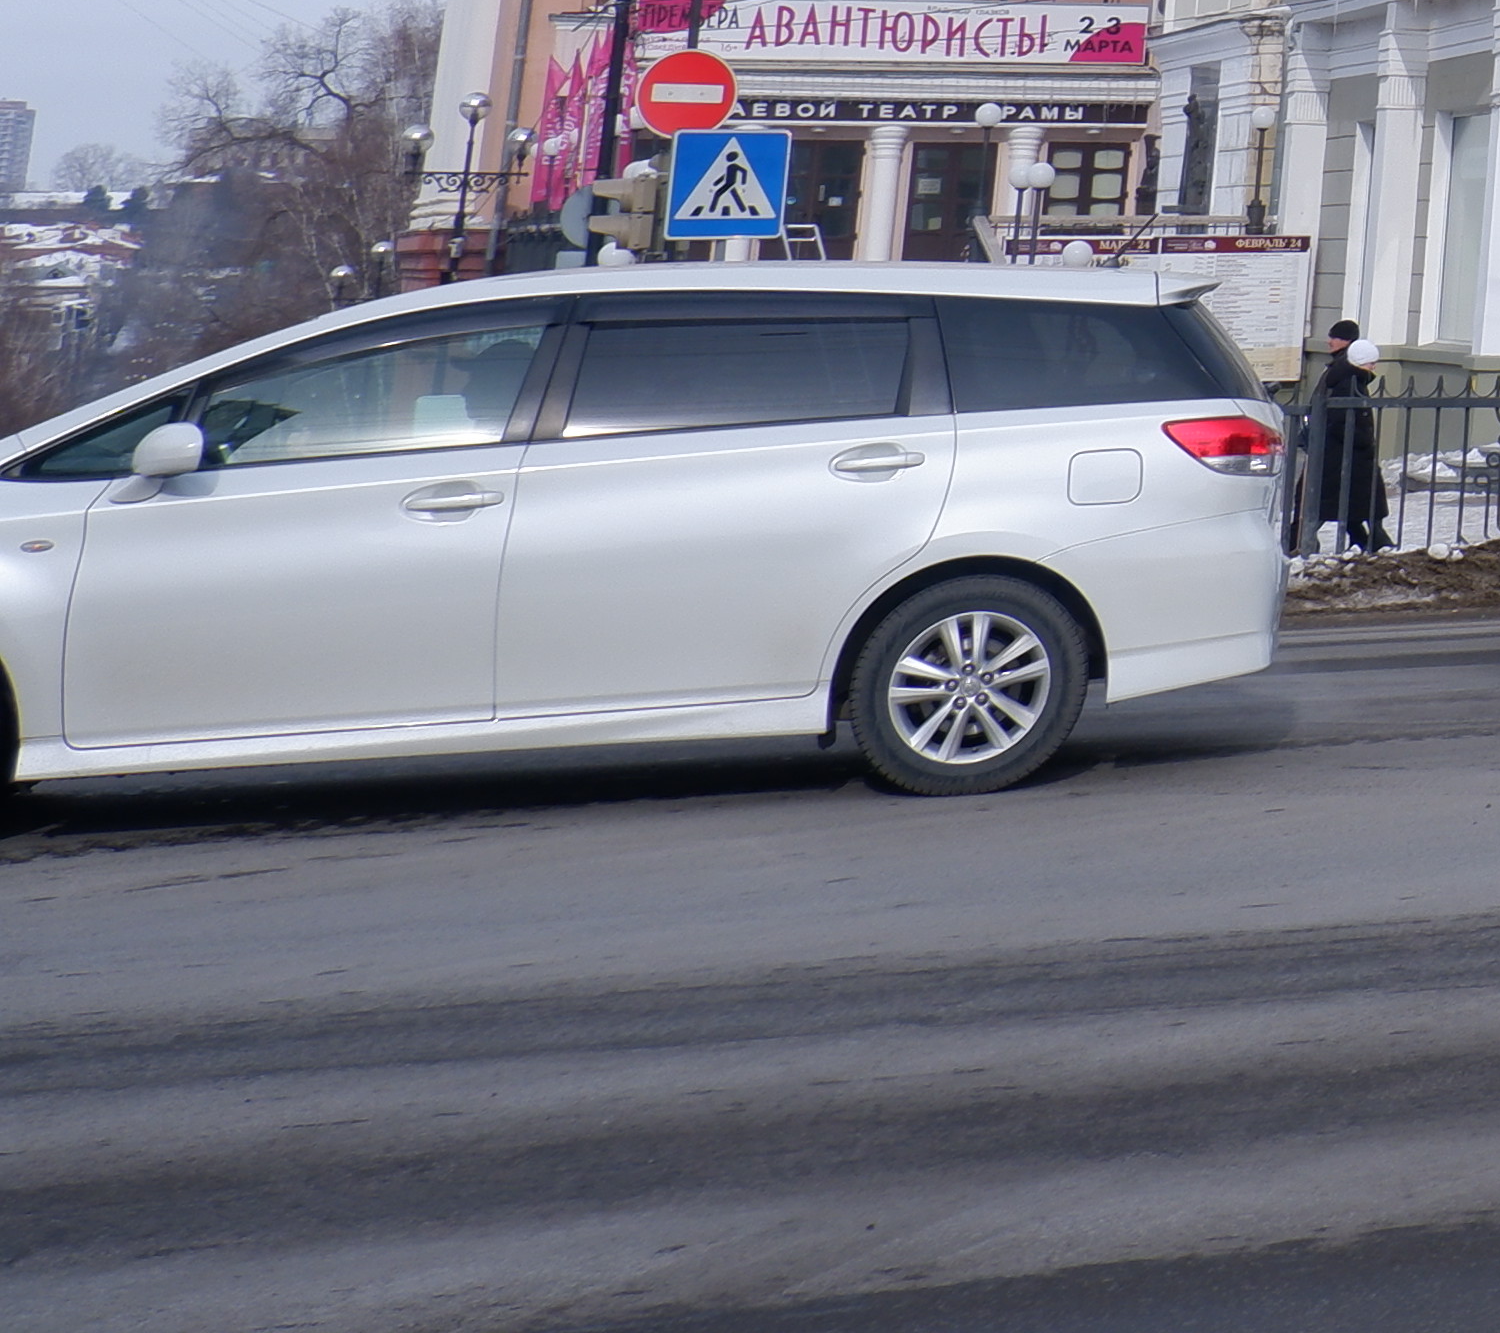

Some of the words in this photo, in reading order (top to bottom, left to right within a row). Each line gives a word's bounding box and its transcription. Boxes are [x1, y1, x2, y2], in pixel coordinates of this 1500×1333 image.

[744, 3, 1048, 58] АВАНТЮРИСТЫ
[1063, 38, 1134, 54] МАРТА
[732, 101, 837, 118] АЕВОЙ
[858, 103, 959, 119] ТЕАТР
[1001, 105, 1085, 121] РАМЫ
[1289, 239, 1302, 248] 24
